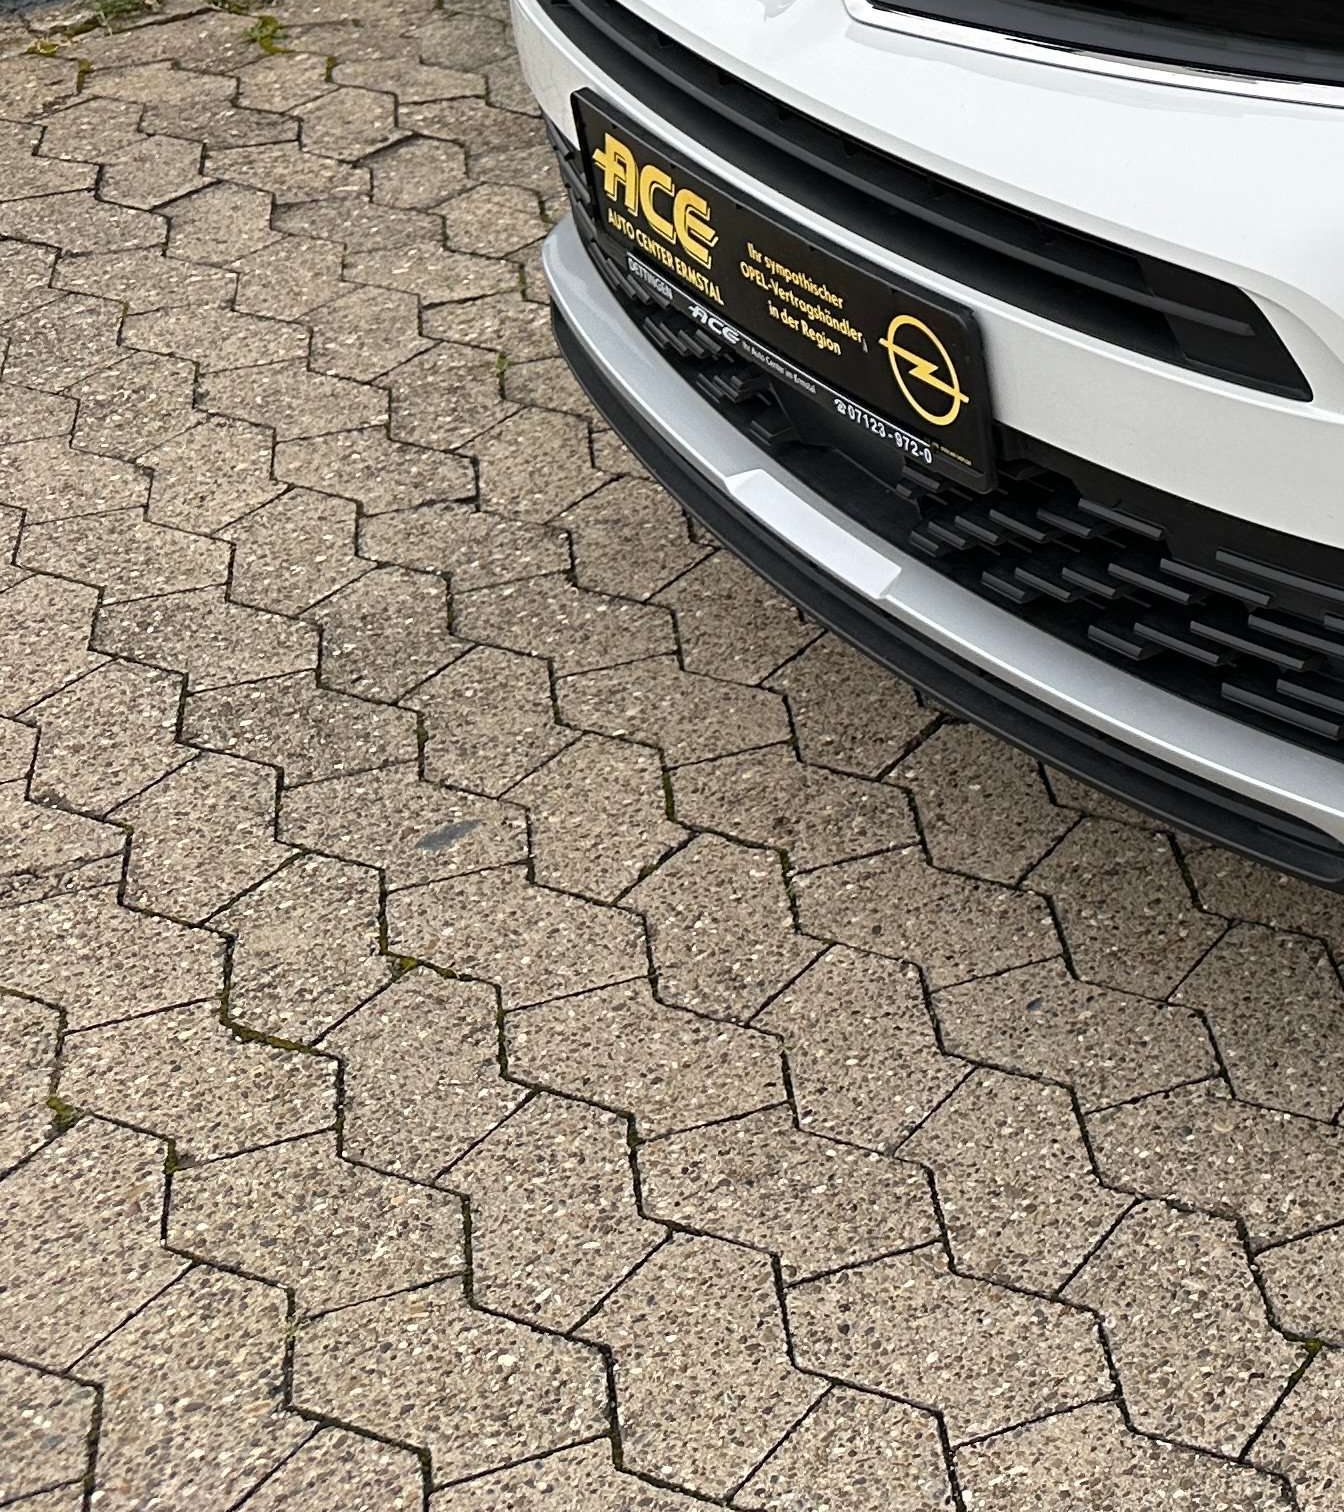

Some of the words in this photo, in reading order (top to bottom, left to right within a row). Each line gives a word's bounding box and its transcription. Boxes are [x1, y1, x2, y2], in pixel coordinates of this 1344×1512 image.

[592, 132, 719, 270] ACE
[608, 207, 635, 240] AUTO
[635, 227, 675, 271] CENTER
[674, 256, 725, 306] ERMSTAL
[747, 242, 763, 263] Ihr
[763, 255, 844, 309] sympathischer
[687, 304, 741, 345] ACE
[768, 299, 780, 320] in
[780, 308, 800, 331] der
[800, 319, 842, 356] Region
